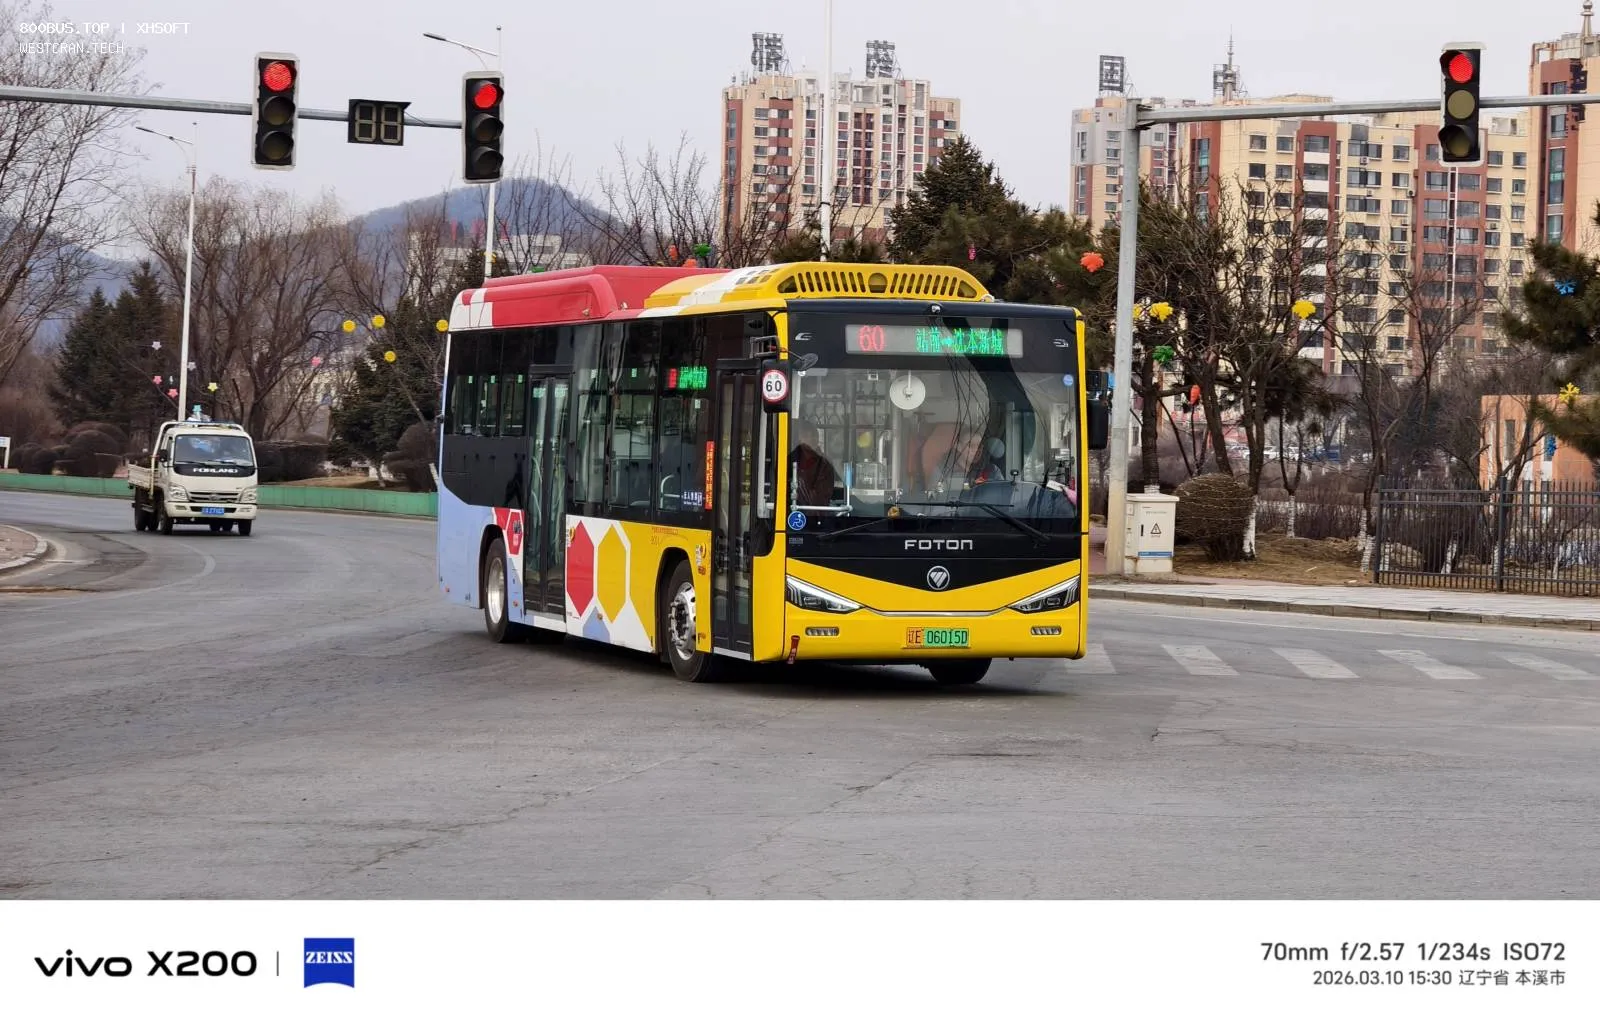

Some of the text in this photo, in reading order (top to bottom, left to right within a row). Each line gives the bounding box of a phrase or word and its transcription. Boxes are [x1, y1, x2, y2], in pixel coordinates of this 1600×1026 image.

[858, 325, 885, 352] 60
[765, 380, 782, 393] 60
[904, 539, 973, 550] FOTON
[927, 630, 968, 644] 06015D
